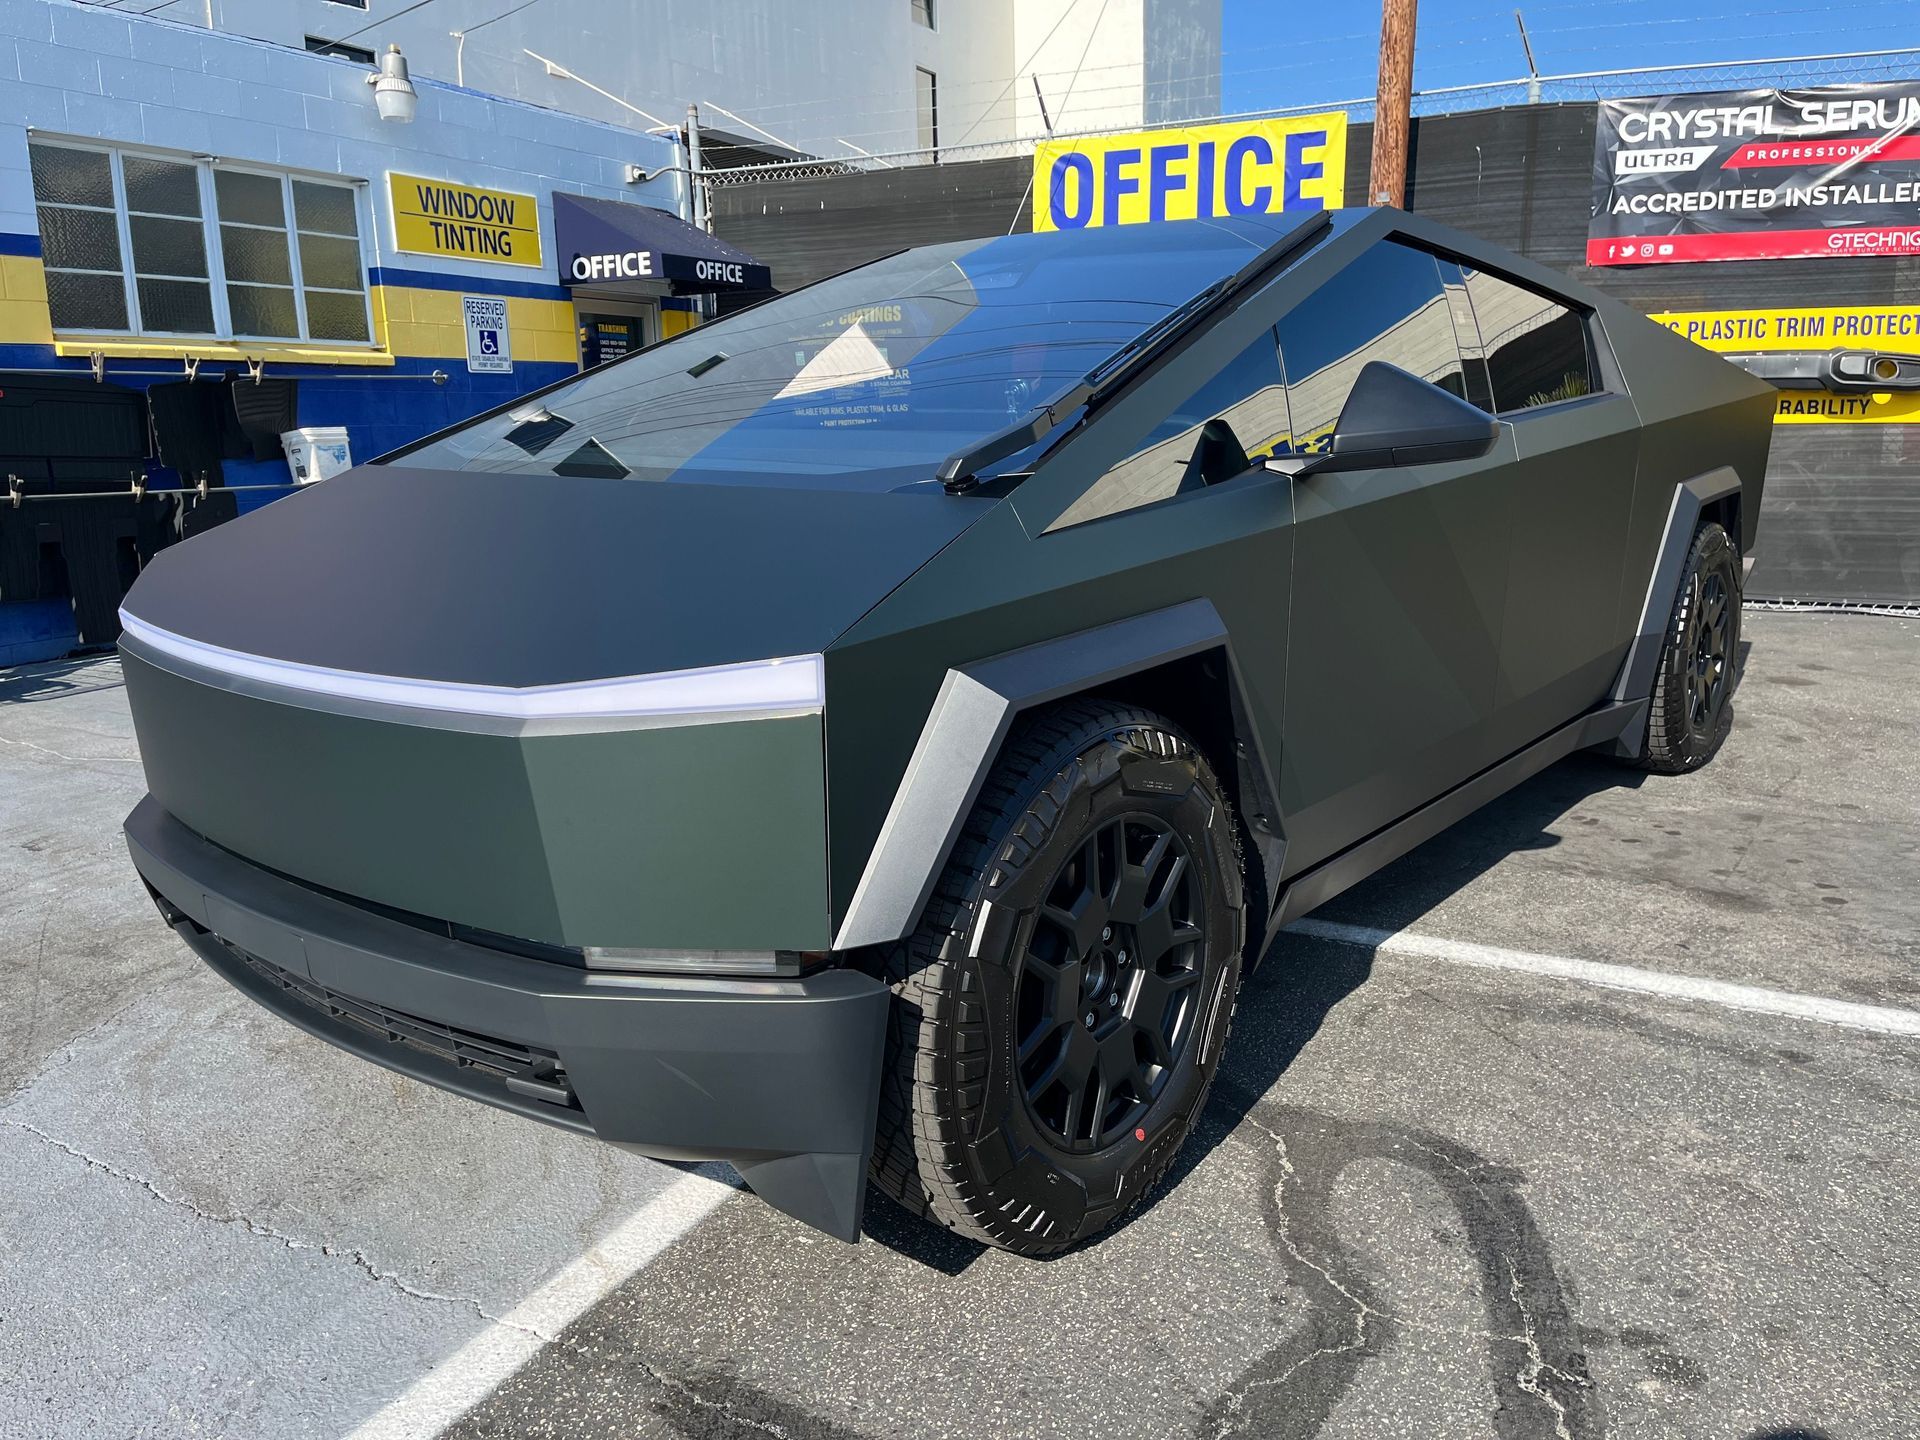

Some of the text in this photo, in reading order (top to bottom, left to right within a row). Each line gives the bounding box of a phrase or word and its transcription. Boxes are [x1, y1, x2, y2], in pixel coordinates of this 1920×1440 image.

[1618, 104, 1785, 143] CRYSTAL
[1624, 151, 1694, 168] ULTRA
[1747, 145, 1882, 160] PROFESSIONAL
[1050, 130, 1327, 231] OFFICE
[416, 184, 515, 225] WINDOW
[1612, 188, 1776, 215] ACCREDITED
[429, 221, 512, 257] TINTING
[572, 251, 653, 280] OFFICE
[696, 260, 744, 283] OFFICE
[465, 300, 505, 316] RESERVED
[470, 315, 503, 330] PARKING
[1687, 317, 1767, 341] PLASTIC
[1775, 316, 1826, 338] TRIM
